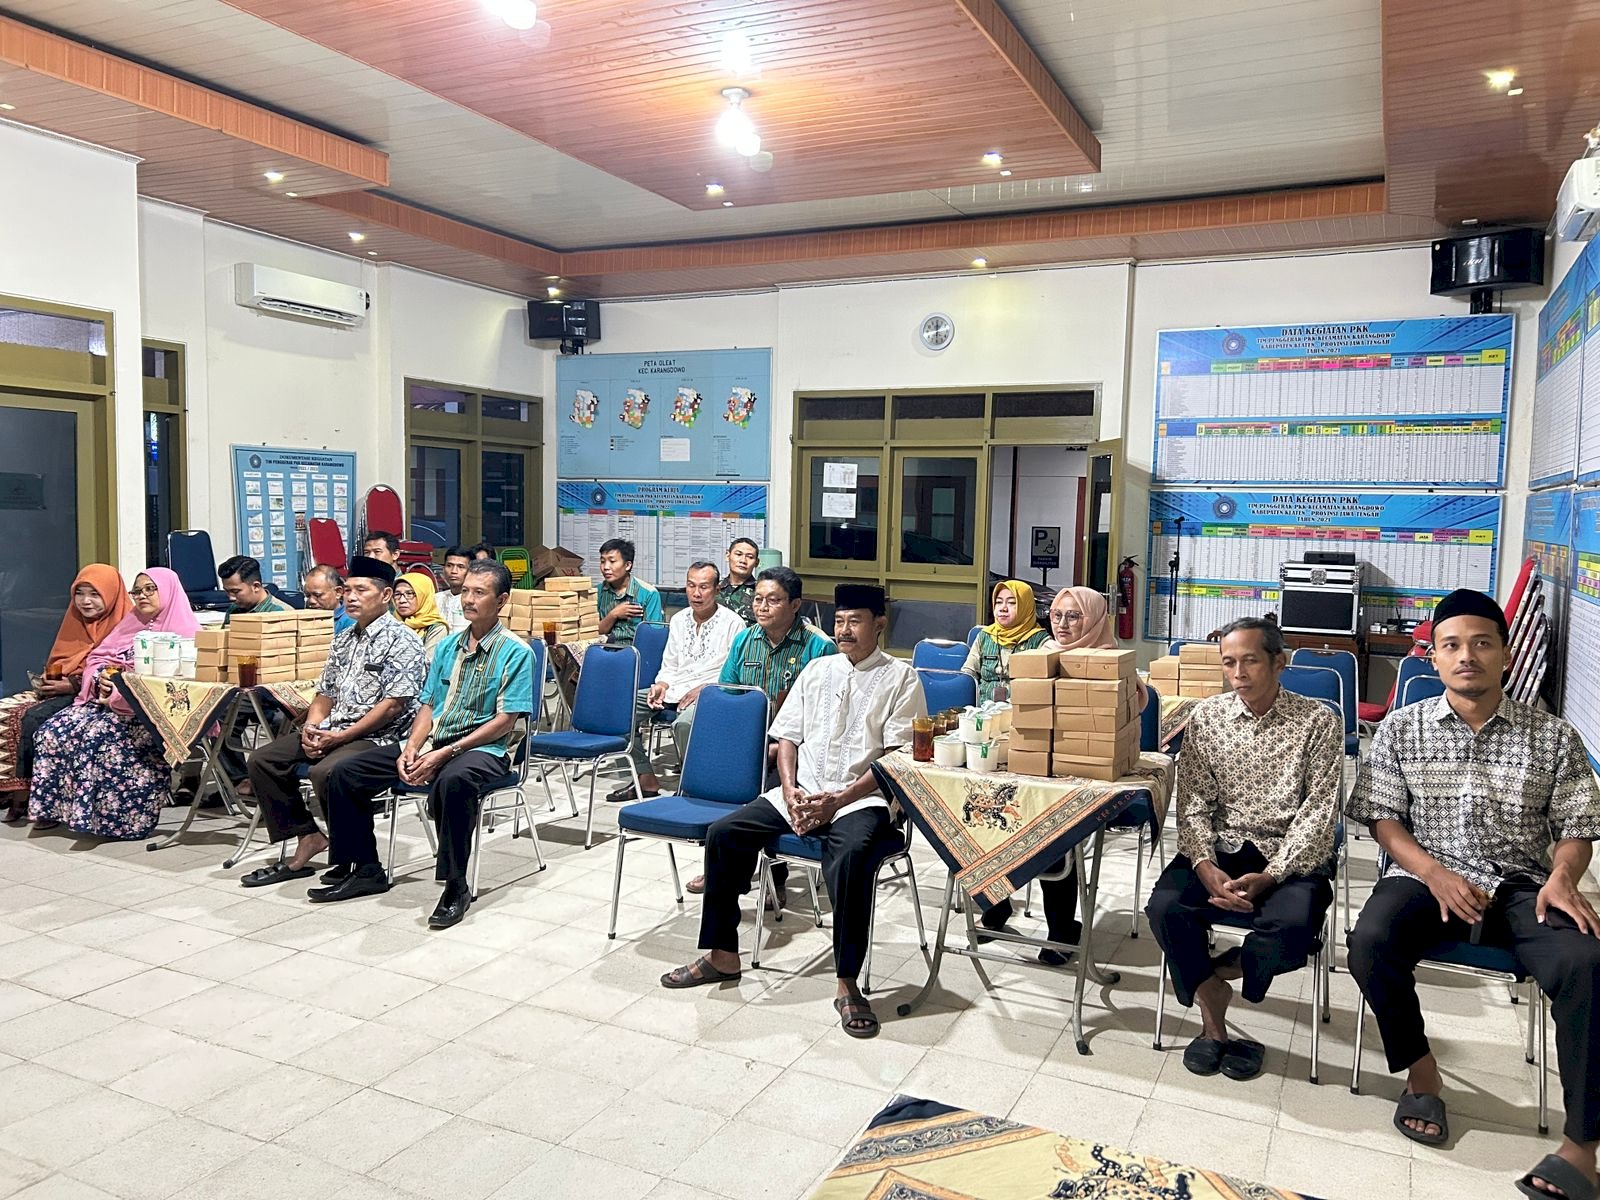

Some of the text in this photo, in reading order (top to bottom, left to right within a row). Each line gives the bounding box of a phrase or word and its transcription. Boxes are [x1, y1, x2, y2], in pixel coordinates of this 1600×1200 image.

[1281, 325, 1369, 336] DATA KEGIATAN PKK
[650, 366, 686, 374] KARANGDOWO
[1272, 495, 1359, 504] DATA KEGIATAN PKK
[1035, 530, 1048, 546] P
